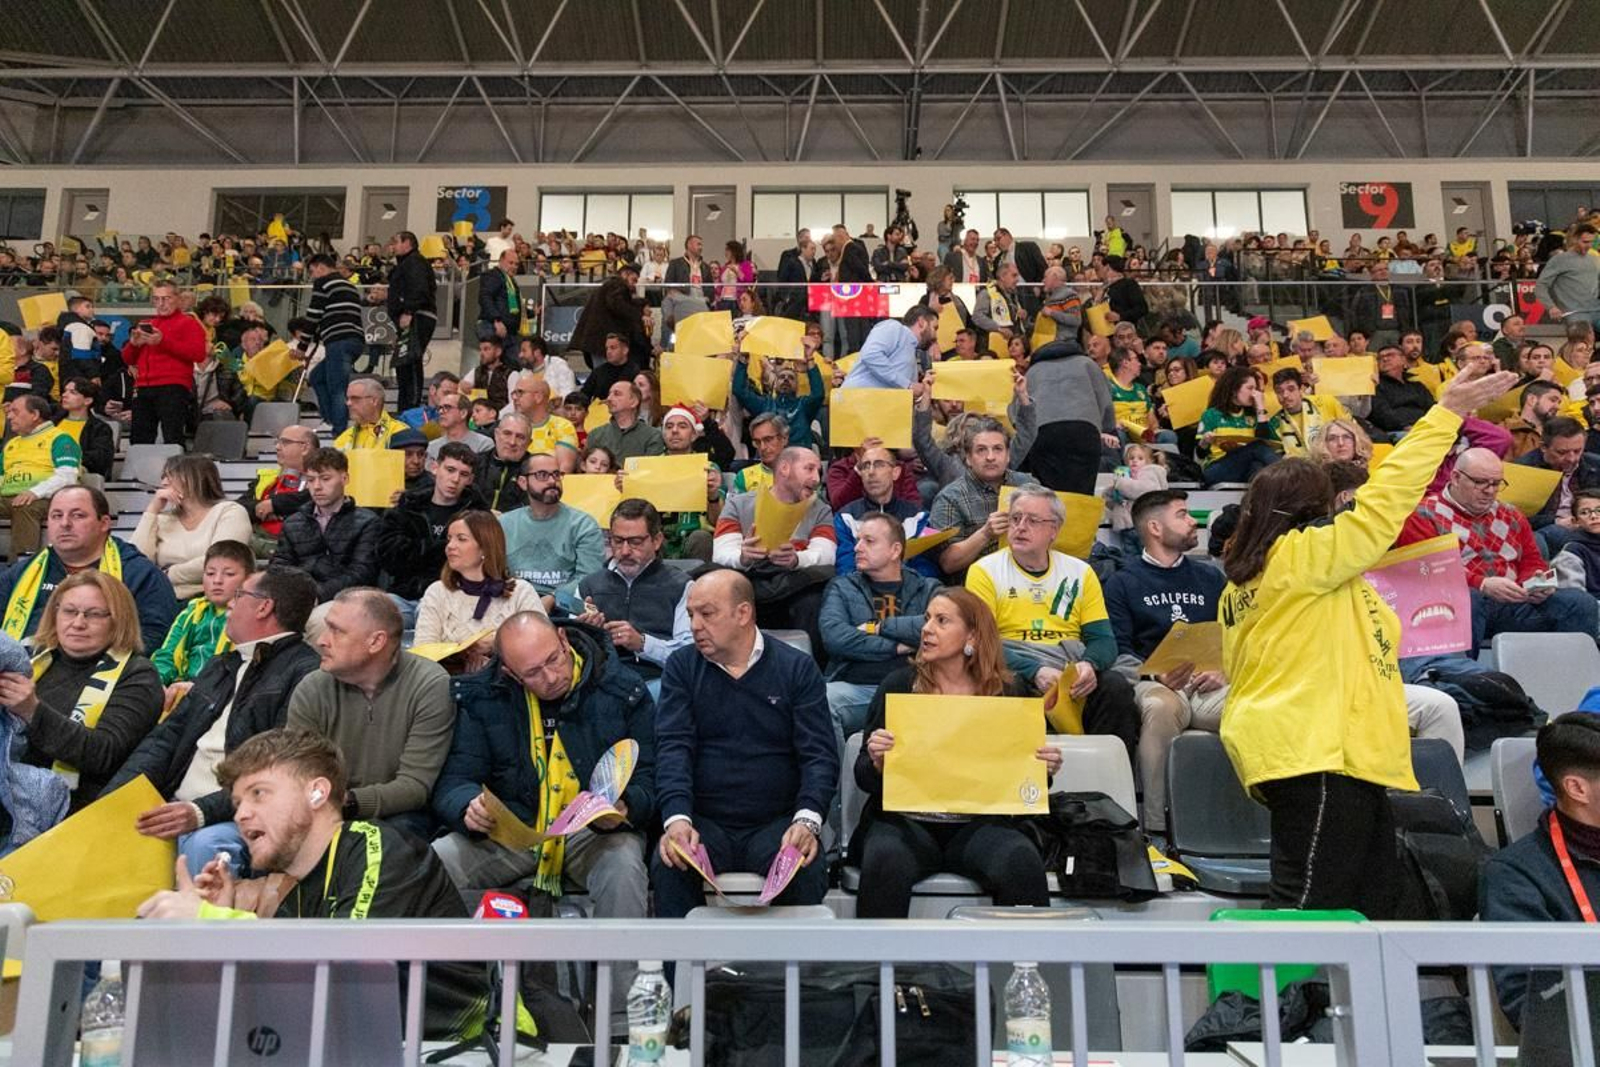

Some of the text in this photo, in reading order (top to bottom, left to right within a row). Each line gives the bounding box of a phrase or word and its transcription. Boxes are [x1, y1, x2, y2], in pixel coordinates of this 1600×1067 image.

[437, 187, 483, 198] Sector
[1341, 183, 1387, 194] Sector
[451, 187, 491, 232] 8
[1358, 183, 1399, 229] 9
[544, 330, 573, 342] Sect
[1143, 592, 1205, 606] SCALPERS
[251, 1025, 278, 1057] hp
